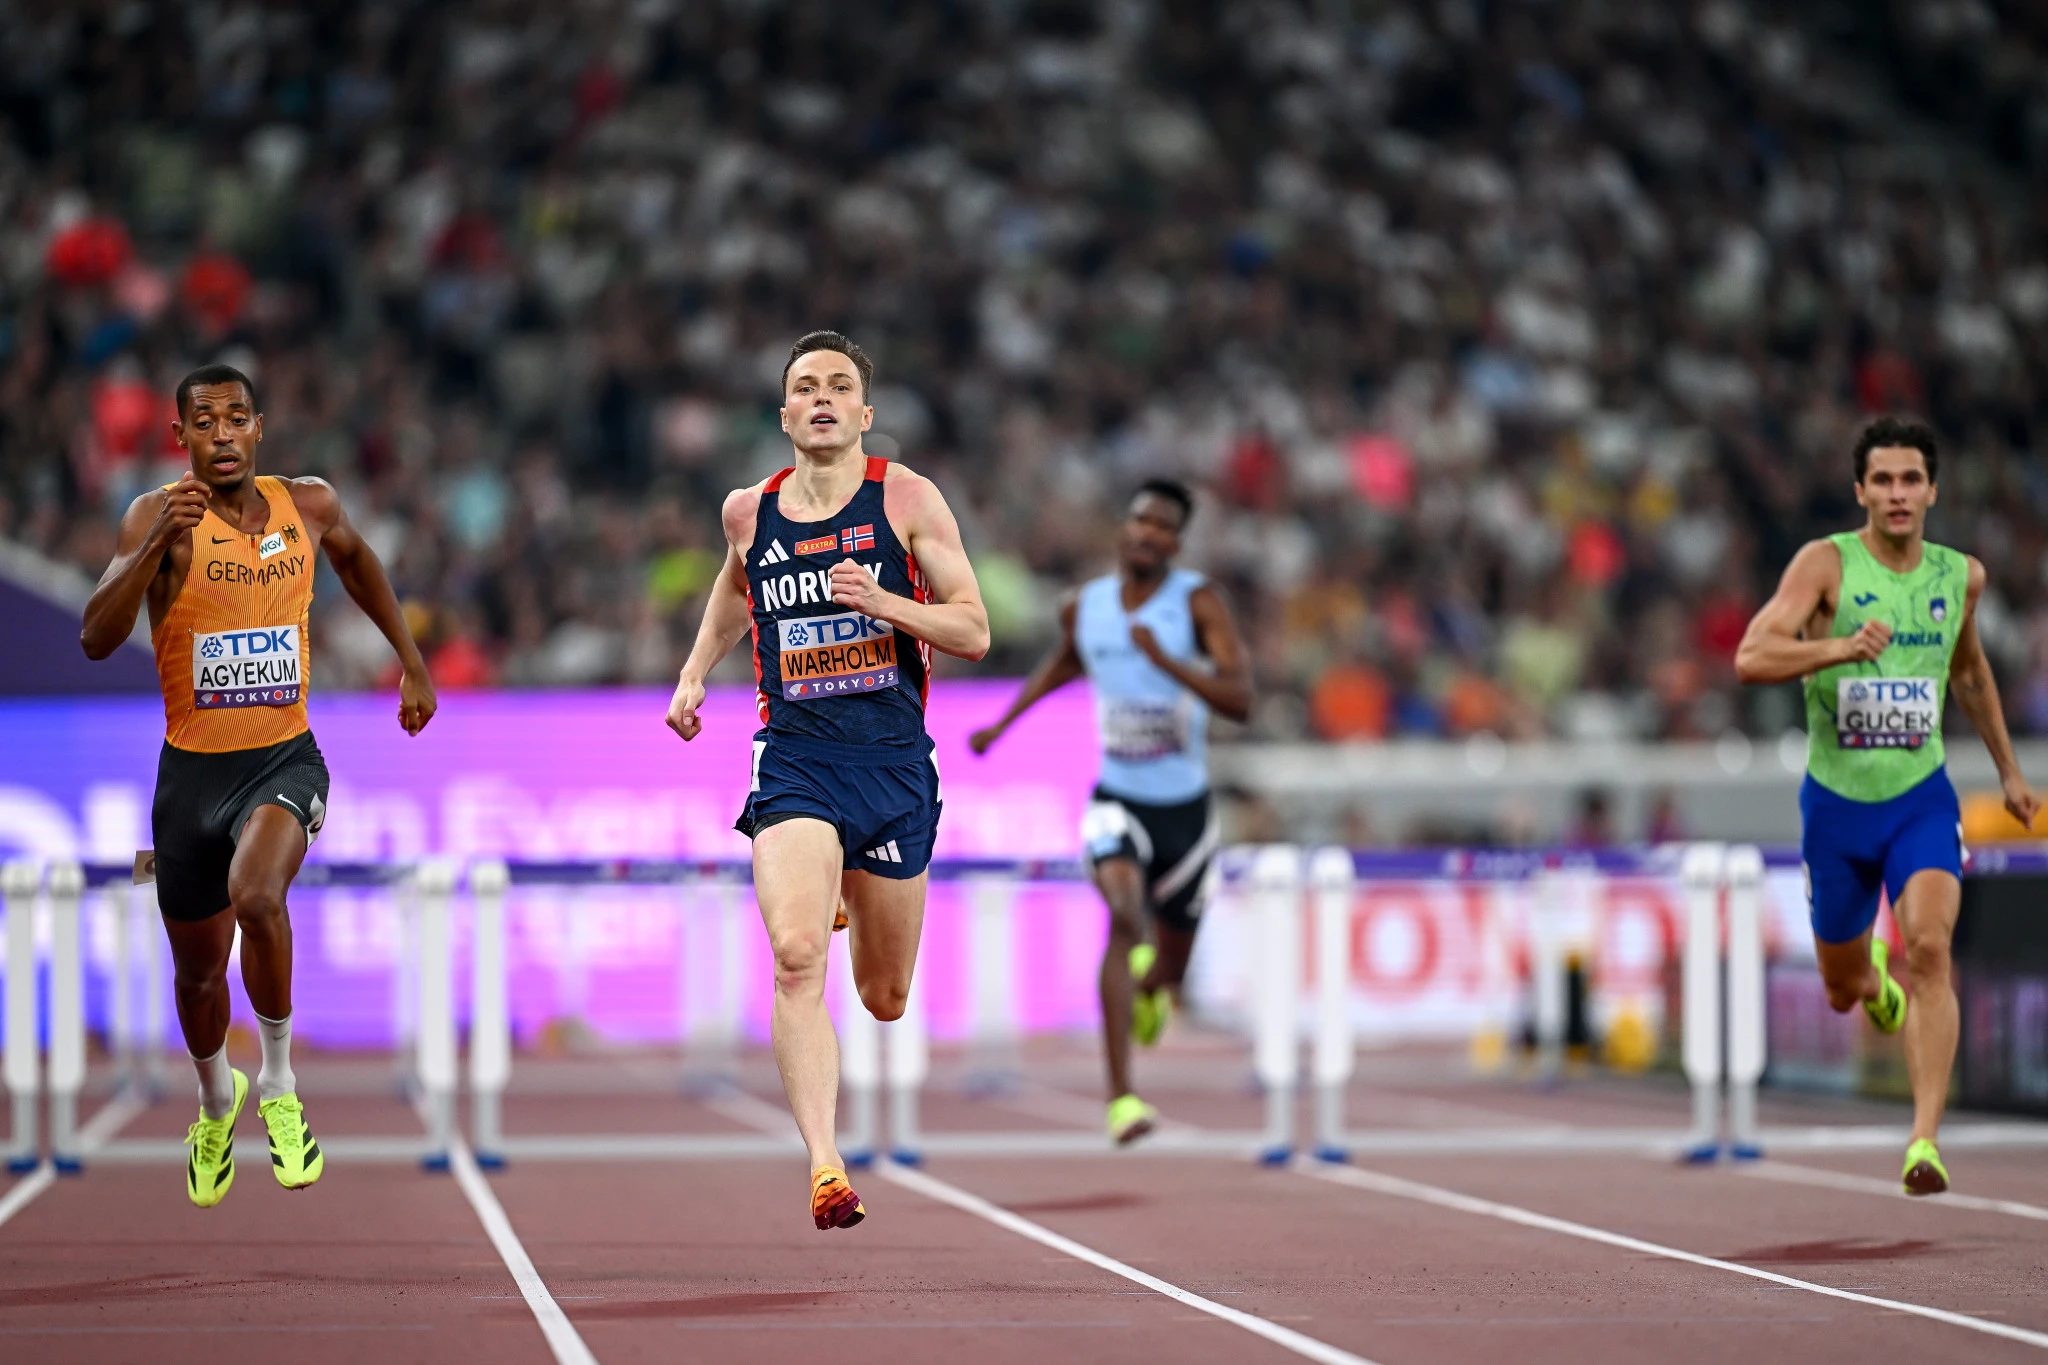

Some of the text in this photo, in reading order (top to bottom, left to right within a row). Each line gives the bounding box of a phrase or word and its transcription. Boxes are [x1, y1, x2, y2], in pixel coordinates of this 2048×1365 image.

[260, 537, 281, 554] WGV
[810, 539, 835, 550] EXTRA
[207, 555, 305, 586] GERMANY
[762, 562, 882, 612] NORWY
[223, 629, 293, 656] TDK
[807, 615, 886, 643] TDK
[786, 640, 891, 677] WARHOLM
[200, 659, 297, 688] AGYEKUM
[1870, 682, 1929, 701] TDK
[1846, 706, 1933, 729] GUČEK
